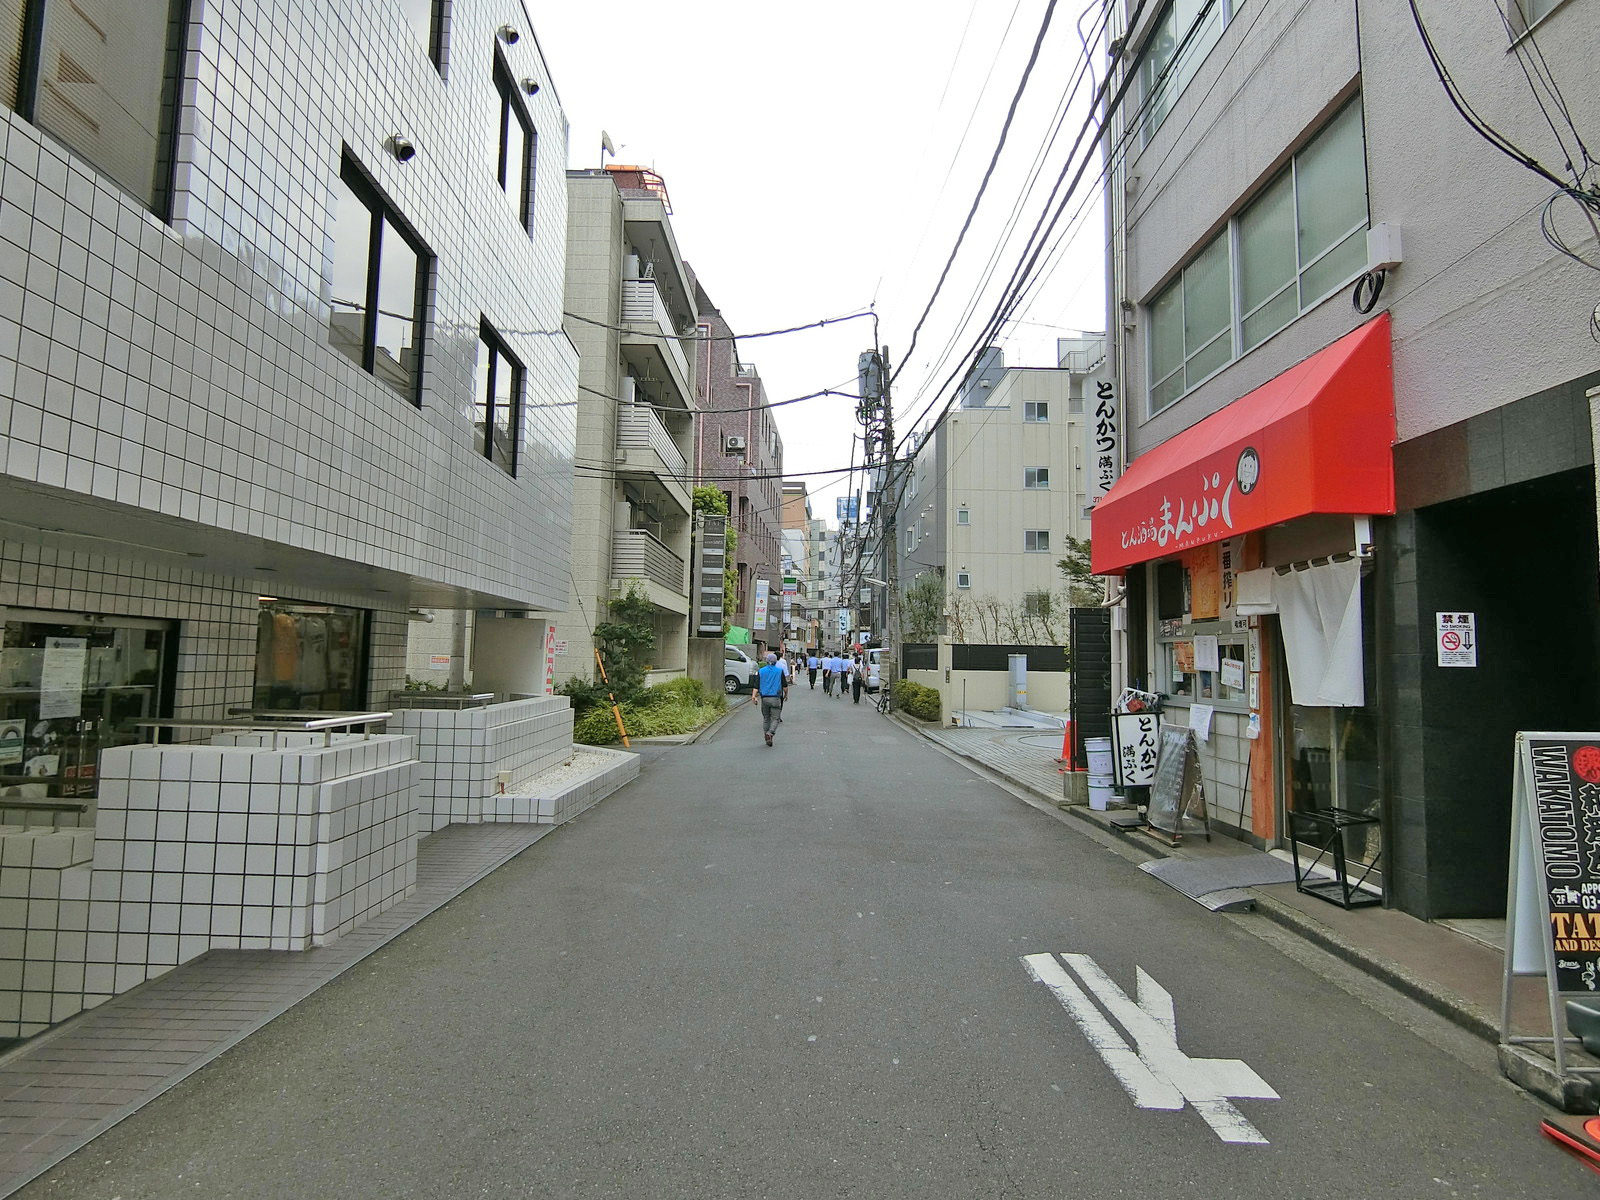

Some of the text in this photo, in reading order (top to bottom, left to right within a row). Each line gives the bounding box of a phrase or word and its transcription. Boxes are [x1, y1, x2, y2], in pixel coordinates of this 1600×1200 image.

[1095, 380, 1116, 453] とんかつ
[1157, 471, 1235, 547] まんぷく
[1441, 614, 1470, 624] 禁煙
[1122, 743, 1138, 784] 満ぷく
[1138, 717, 1157, 780] とんかつ
[1532, 745, 1582, 880] WAKATOMO
[1556, 894, 1567, 905] 2F
[1554, 939, 1579, 952] AND
